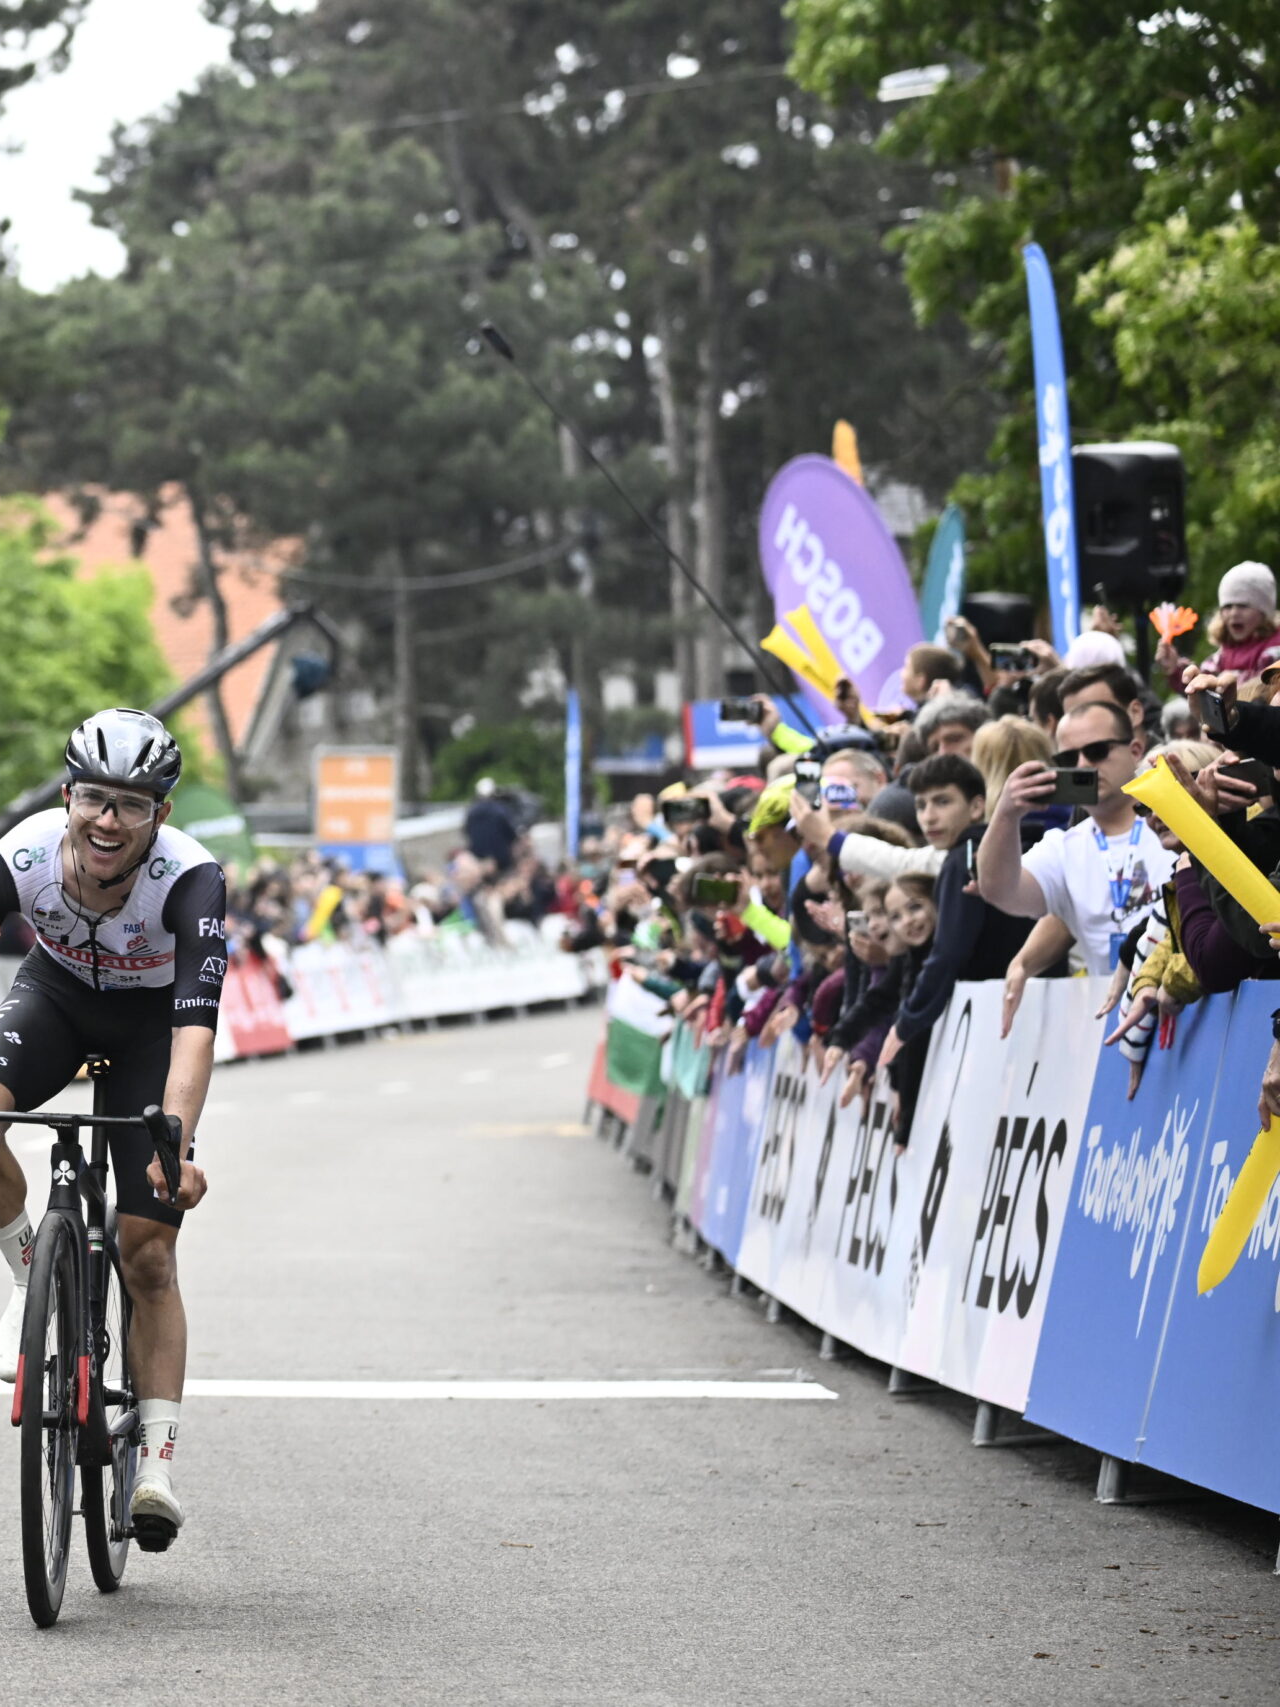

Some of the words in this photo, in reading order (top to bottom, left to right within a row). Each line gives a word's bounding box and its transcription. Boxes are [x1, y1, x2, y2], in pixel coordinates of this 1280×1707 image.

[12, 847, 47, 872] G42
[148, 856, 182, 880] G42
[123, 923, 141, 934] FAB
[174, 995, 220, 1010] Emirat
